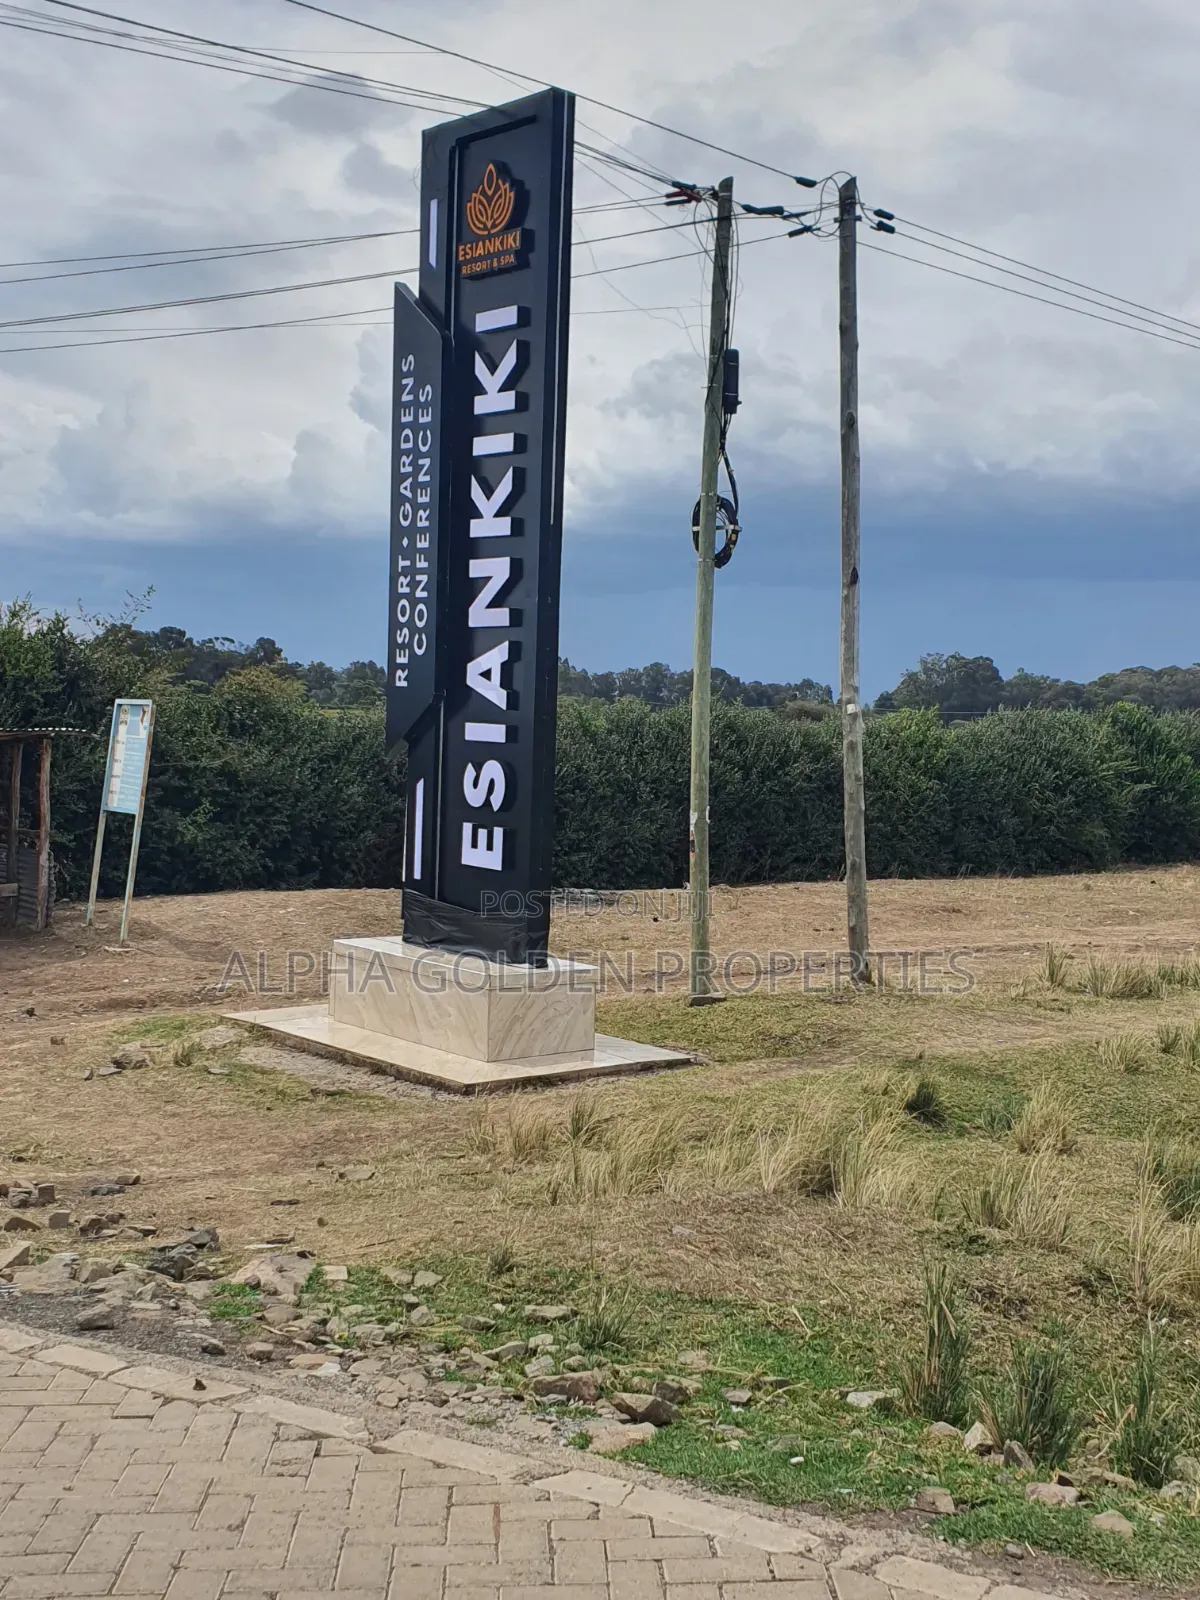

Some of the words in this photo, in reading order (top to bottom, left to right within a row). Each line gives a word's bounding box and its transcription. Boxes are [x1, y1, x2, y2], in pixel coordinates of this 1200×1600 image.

[458, 231, 520, 261] ESIANKIKI
[461, 260, 491, 275] RESORT
[492, 257, 498, 268] &
[500, 254, 515, 266] SPA
[399, 353, 415, 527] GARDENS
[413, 384, 432, 656] CONFERENCES
[461, 304, 519, 871] ESIANKIKI
[395, 555, 411, 688] RESORT
